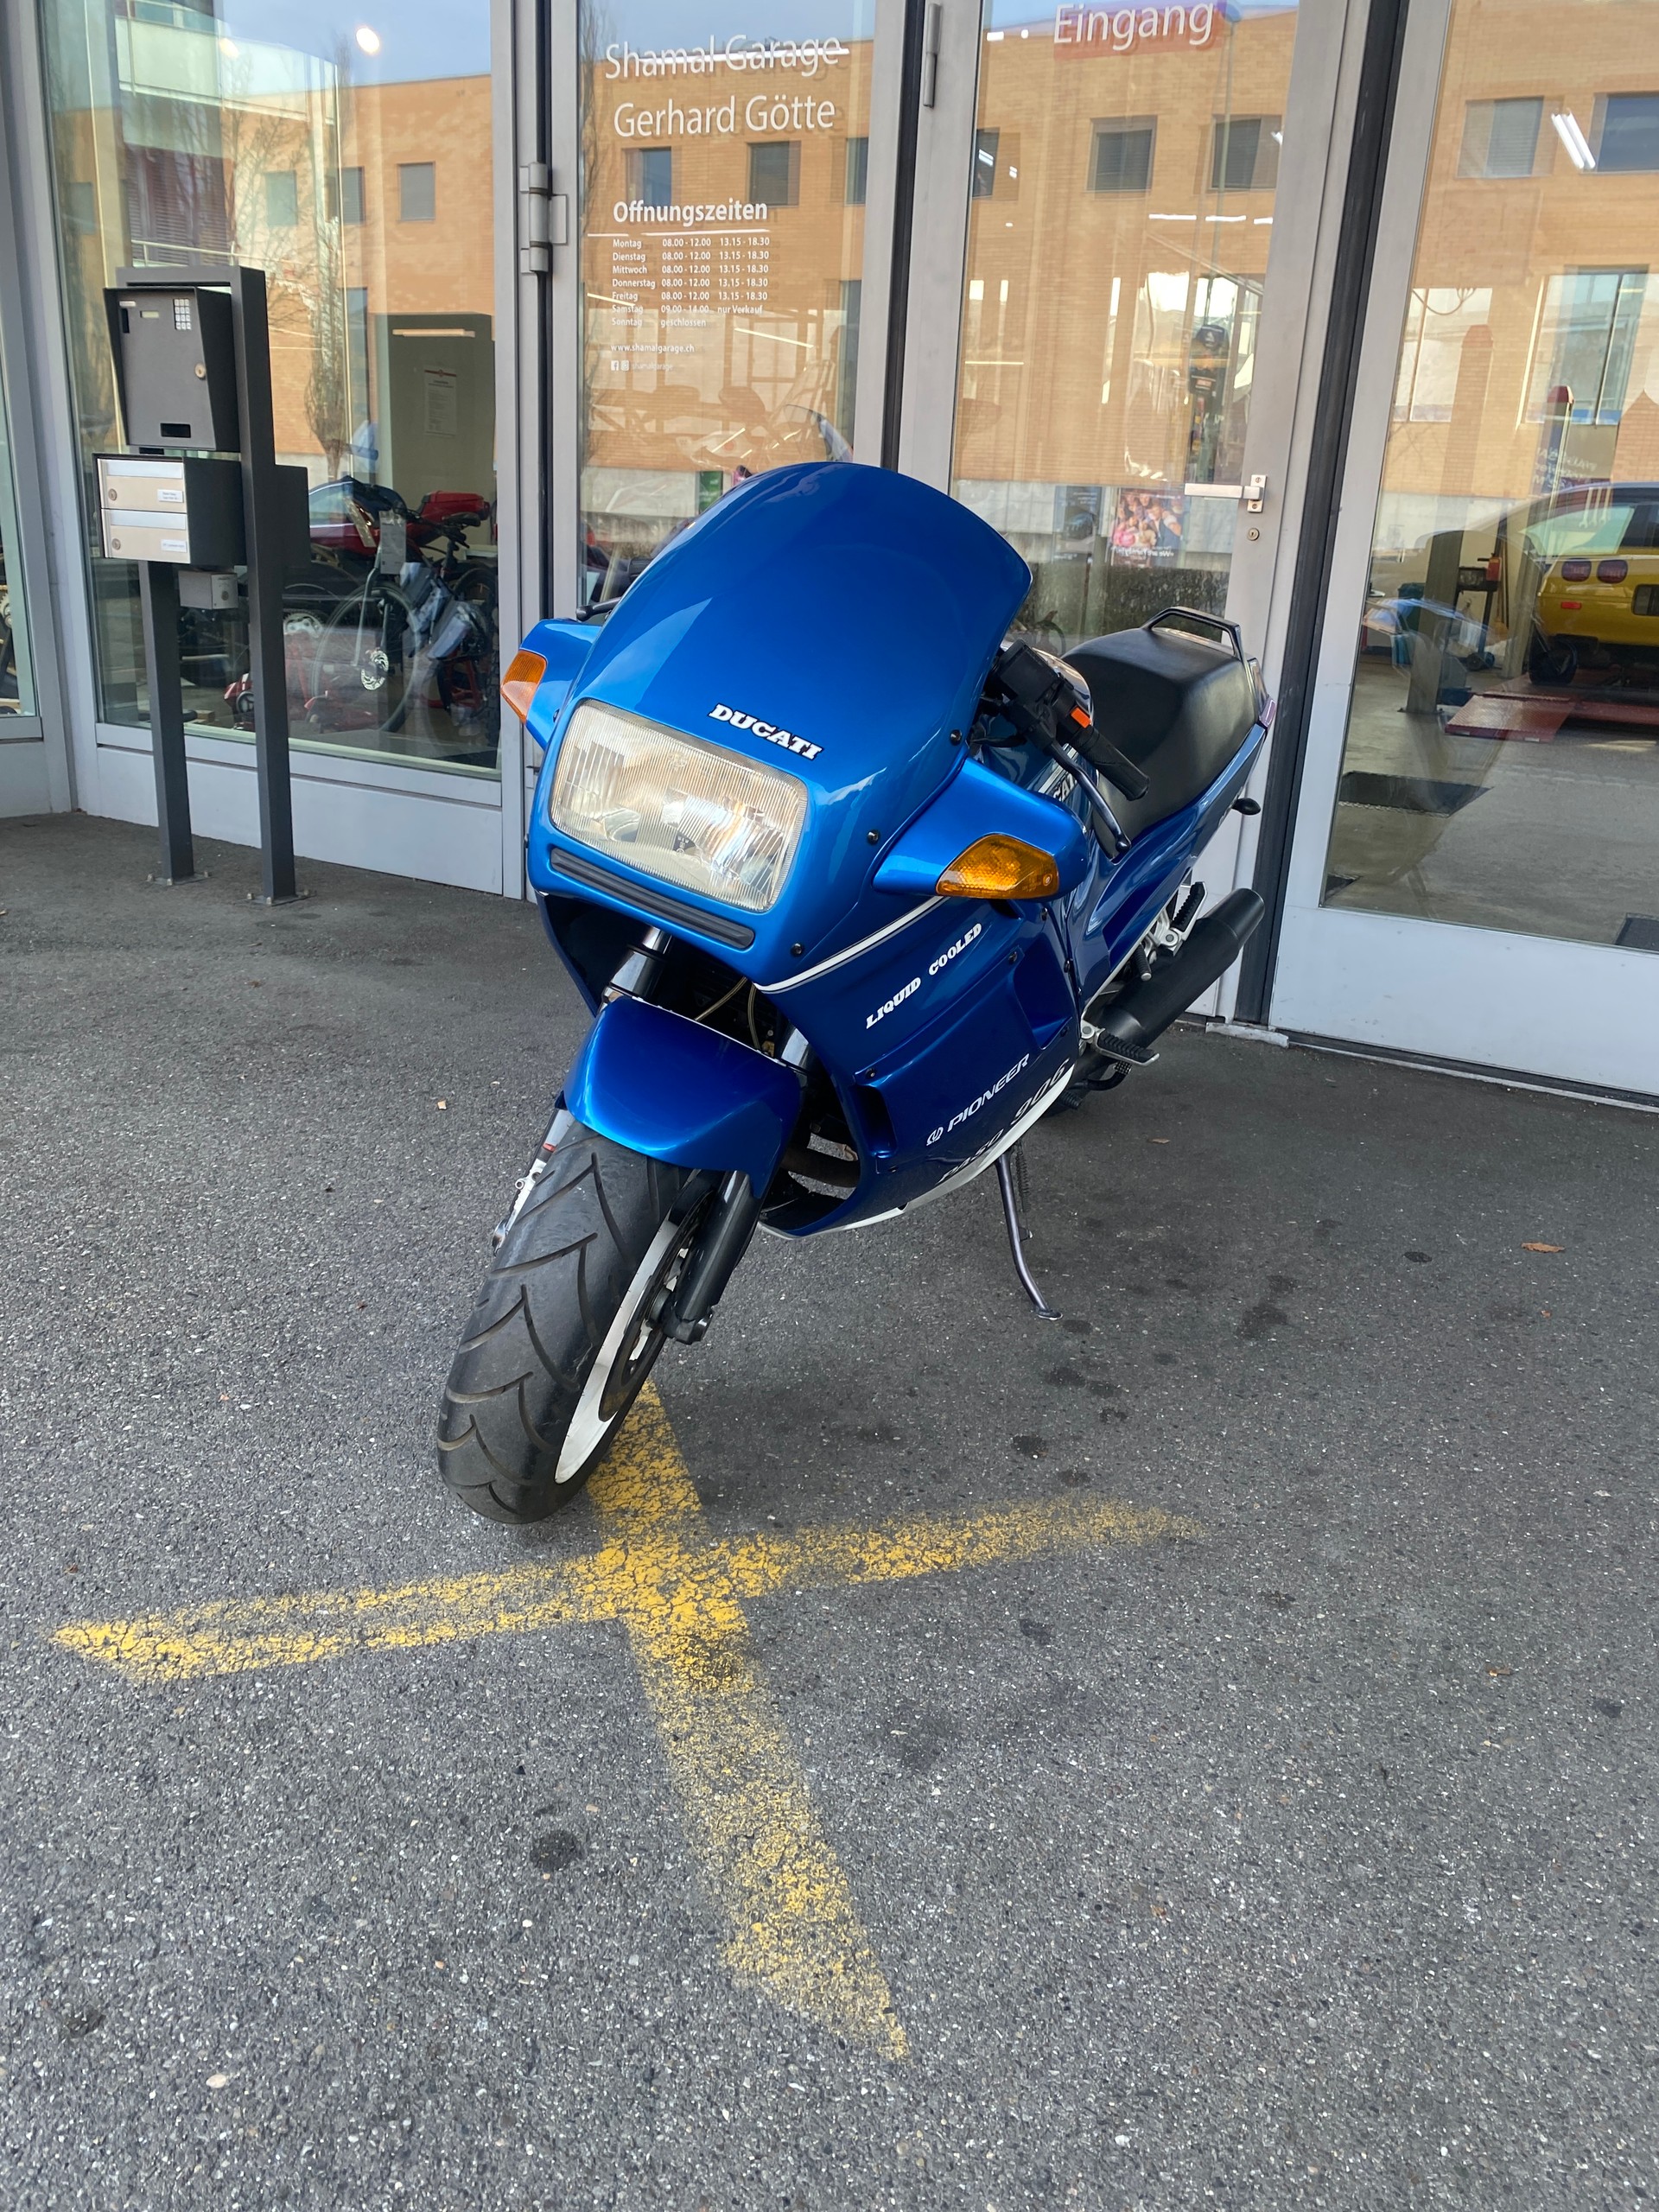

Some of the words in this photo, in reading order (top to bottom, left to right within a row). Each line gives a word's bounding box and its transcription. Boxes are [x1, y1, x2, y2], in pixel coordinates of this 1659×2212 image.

[1054, 3, 1214, 51] Eingang
[606, 35, 715, 79] Shamal
[725, 35, 841, 77] Garage
[613, 95, 735, 137] Gerhard
[745, 94, 836, 131] Götte
[613, 238, 642, 250] Montag
[662, 238, 683, 247] 08.00
[690, 238, 711, 246] 12.00
[720, 238, 741, 246] 13.15
[748, 237, 770, 245] 18.30
[613, 251, 645, 263] Dienstag
[662, 251, 683, 260] 08.00
[690, 251, 710, 260] 12.00
[720, 251, 741, 260] 13.15
[747, 251, 769, 259] 18.30
[612, 264, 647, 274] Mittwoch
[662, 265, 683, 274] 08.00
[689, 264, 710, 273] 12.00
[719, 264, 741, 273] 13.15
[747, 264, 769, 273] 18.30
[612, 278, 656, 289] Donnerstag
[661, 278, 683, 287] 08.00
[689, 278, 710, 287] 12.00
[719, 278, 740, 287] 13.15
[747, 278, 768, 287] 18.30
[612, 291, 639, 302] Freitag
[661, 291, 683, 301] 08.00
[689, 291, 709, 300] 12.00
[718, 291, 739, 300] 13.15
[747, 291, 767, 300] 18.30
[612, 304, 644, 315] Samstag
[732, 304, 763, 314] Verkauf
[612, 318, 643, 327] Sonntag
[660, 317, 706, 327] geschlossen
[610, 343, 695, 353] www.shamalgarage.ch
[708, 703, 823, 760] DUCATI
[866, 977, 921, 1029] LIQUID
[929, 923, 982, 976] COOLED
[947, 1053, 1030, 1132] PIONEER
